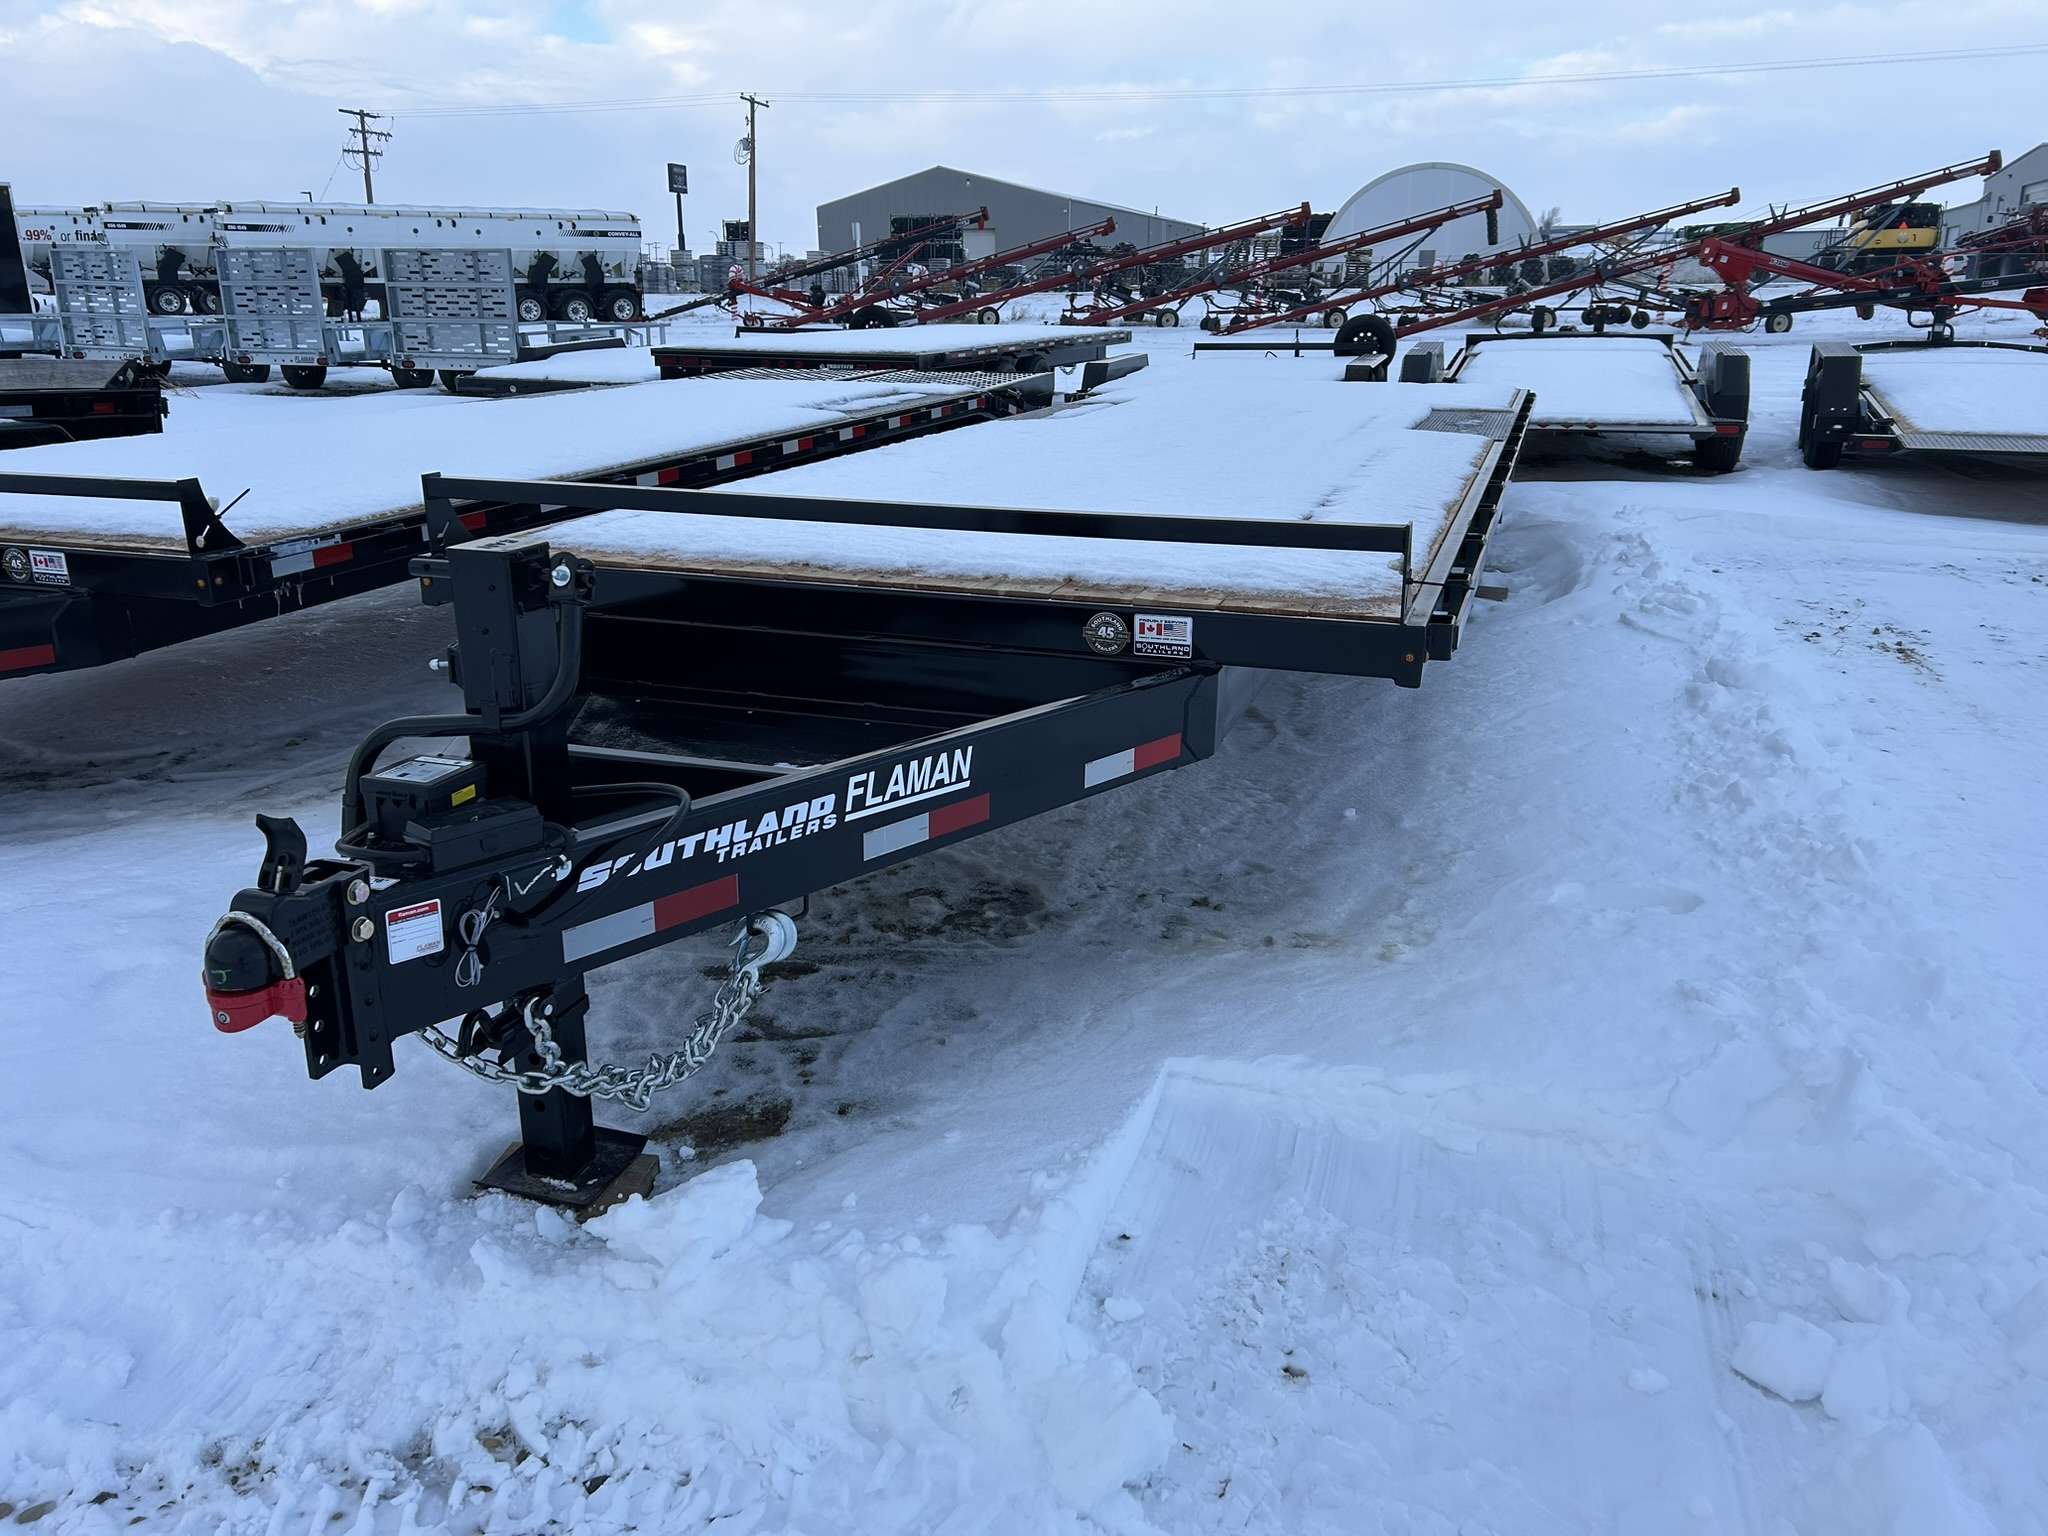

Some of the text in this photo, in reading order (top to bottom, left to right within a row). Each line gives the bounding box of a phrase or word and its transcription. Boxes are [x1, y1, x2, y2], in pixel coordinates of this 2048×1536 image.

[61, 233, 71, 242] or
[11, 559, 22, 569] 45
[1091, 616, 1123, 631] SOUTHLAND
[1097, 626, 1115, 639] 45
[1136, 643, 1190, 652] SOUTHLAND
[845, 745, 973, 812] FLAMAN
[716, 813, 838, 863] TRAILERS
